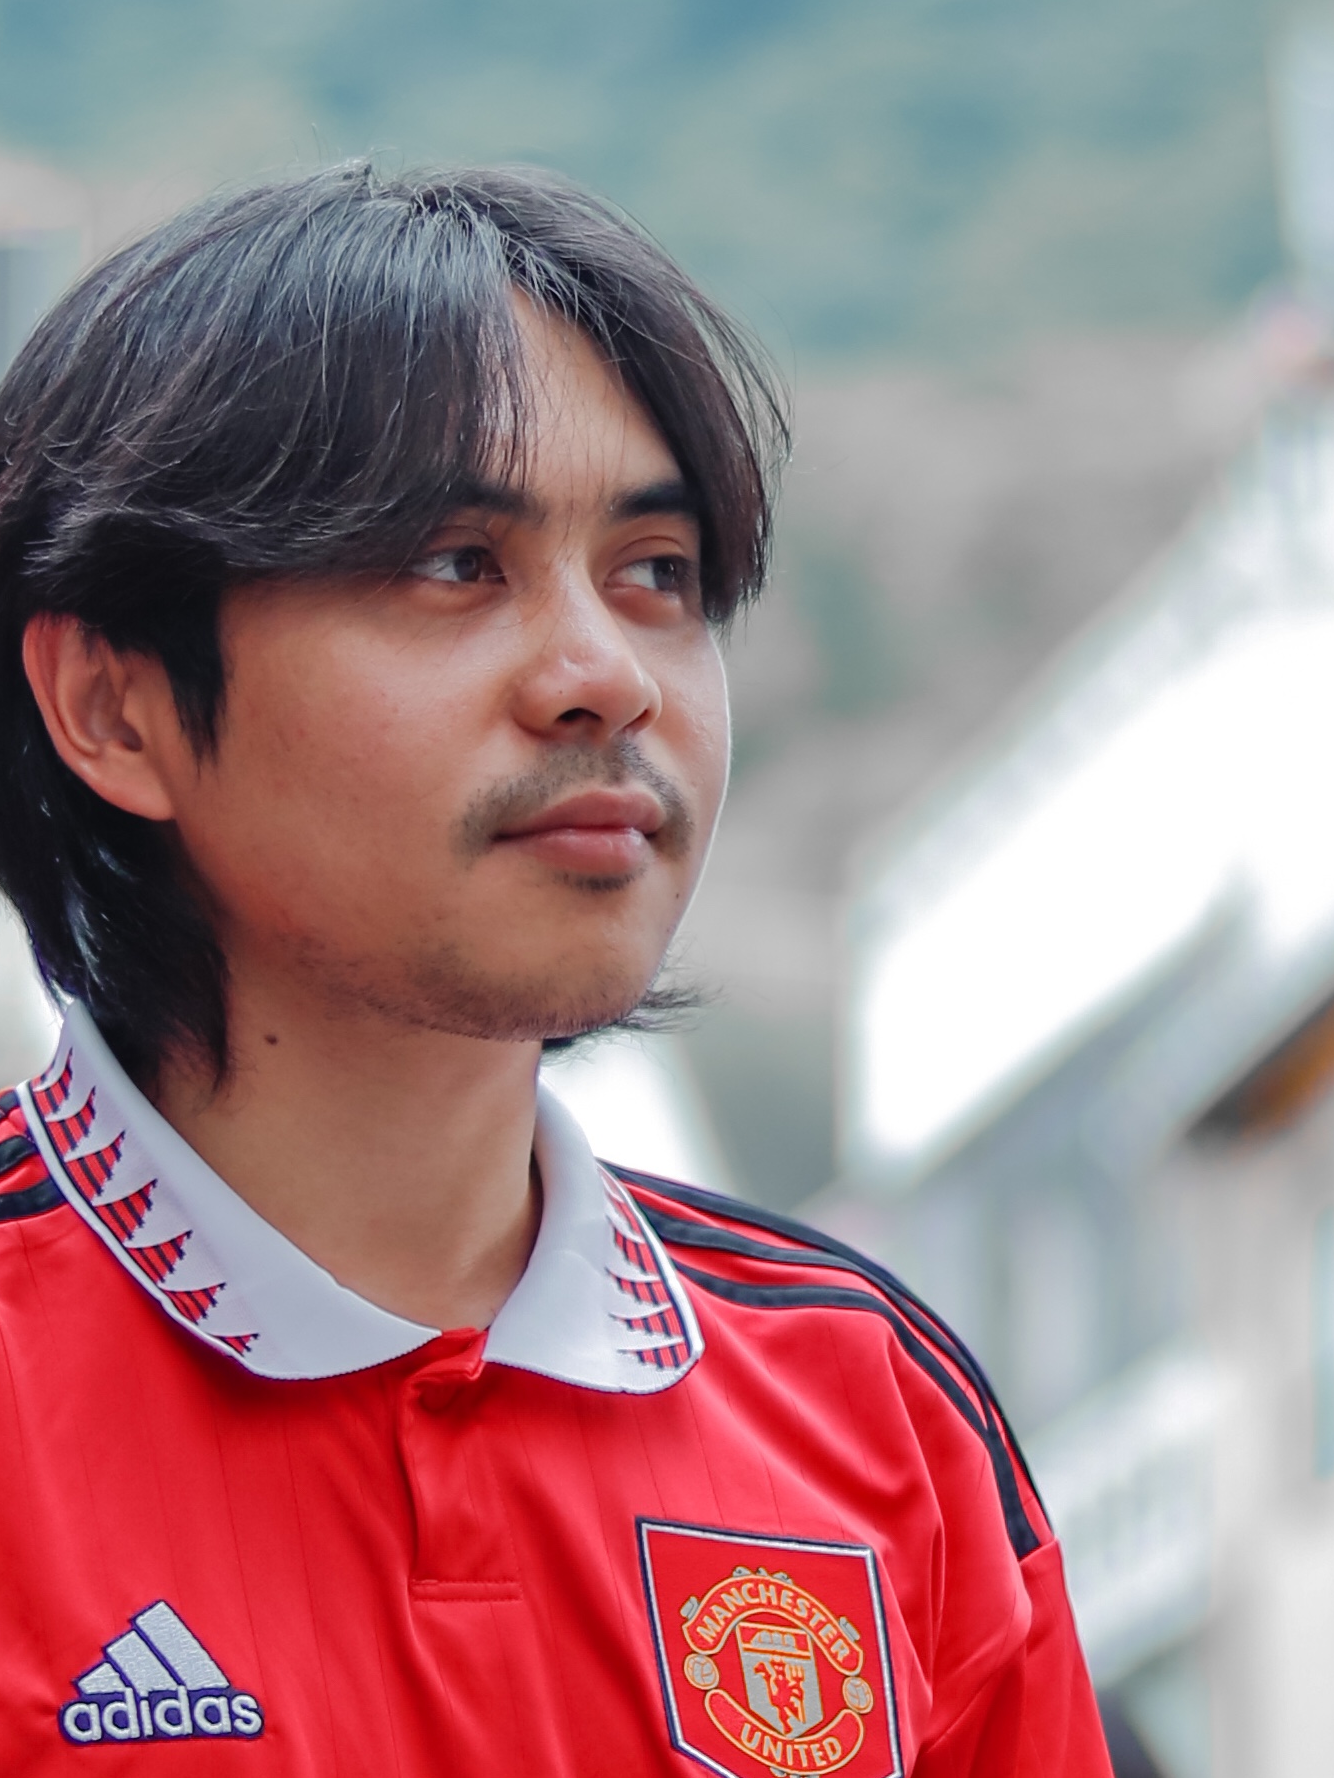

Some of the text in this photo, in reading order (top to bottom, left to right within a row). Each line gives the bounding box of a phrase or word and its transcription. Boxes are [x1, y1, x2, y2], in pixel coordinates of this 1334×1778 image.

[696, 1583, 851, 1664] MANCHESTER
[63, 1684, 264, 1742] adidas
[740, 1722, 842, 1767] UNITED
